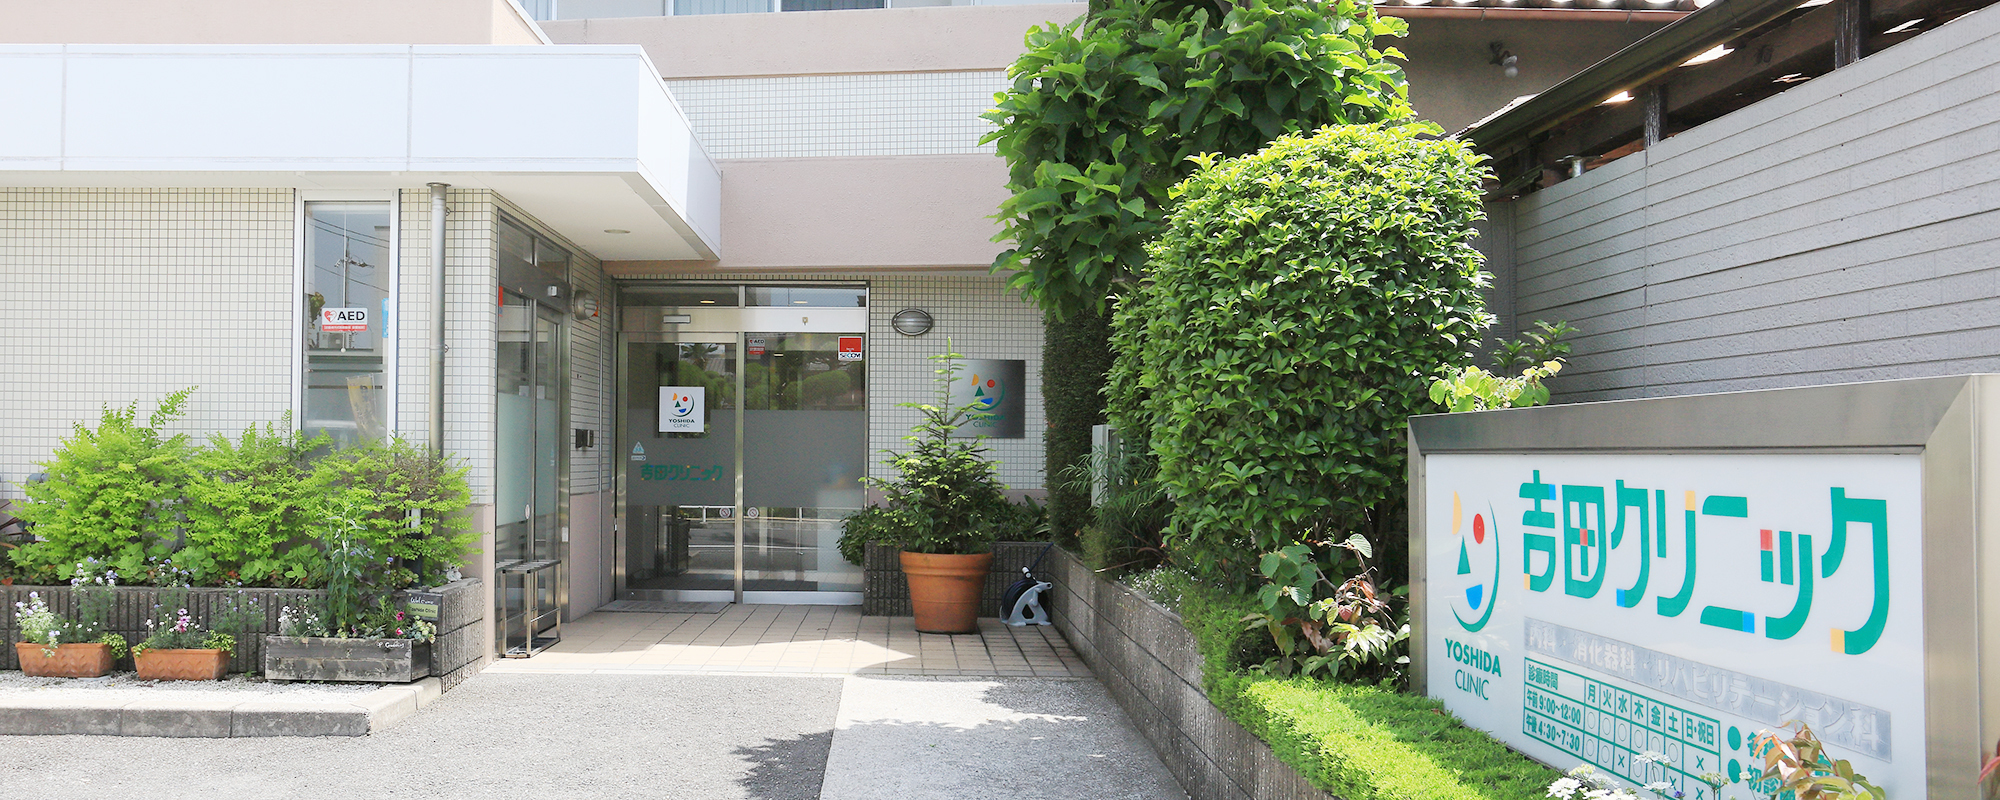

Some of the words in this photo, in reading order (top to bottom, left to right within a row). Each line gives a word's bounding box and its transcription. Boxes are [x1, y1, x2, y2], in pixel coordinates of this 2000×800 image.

[337, 311, 365, 321] AED
[640, 462, 723, 481] 吉田クリニック
[1519, 469, 1890, 656] 吉田クリニック
[1444, 638, 1502, 678] YOSHIDA
[1455, 669, 1490, 701] CLINIC
[1528, 664, 1559, 691] 診療時間
[1587, 684, 1596, 704] 月
[1602, 689, 1612, 709] 火
[1618, 694, 1628, 714] 水
[1634, 700, 1644, 719] 木
[1650, 706, 1661, 727] 金
[1668, 712, 1679, 733] 土
